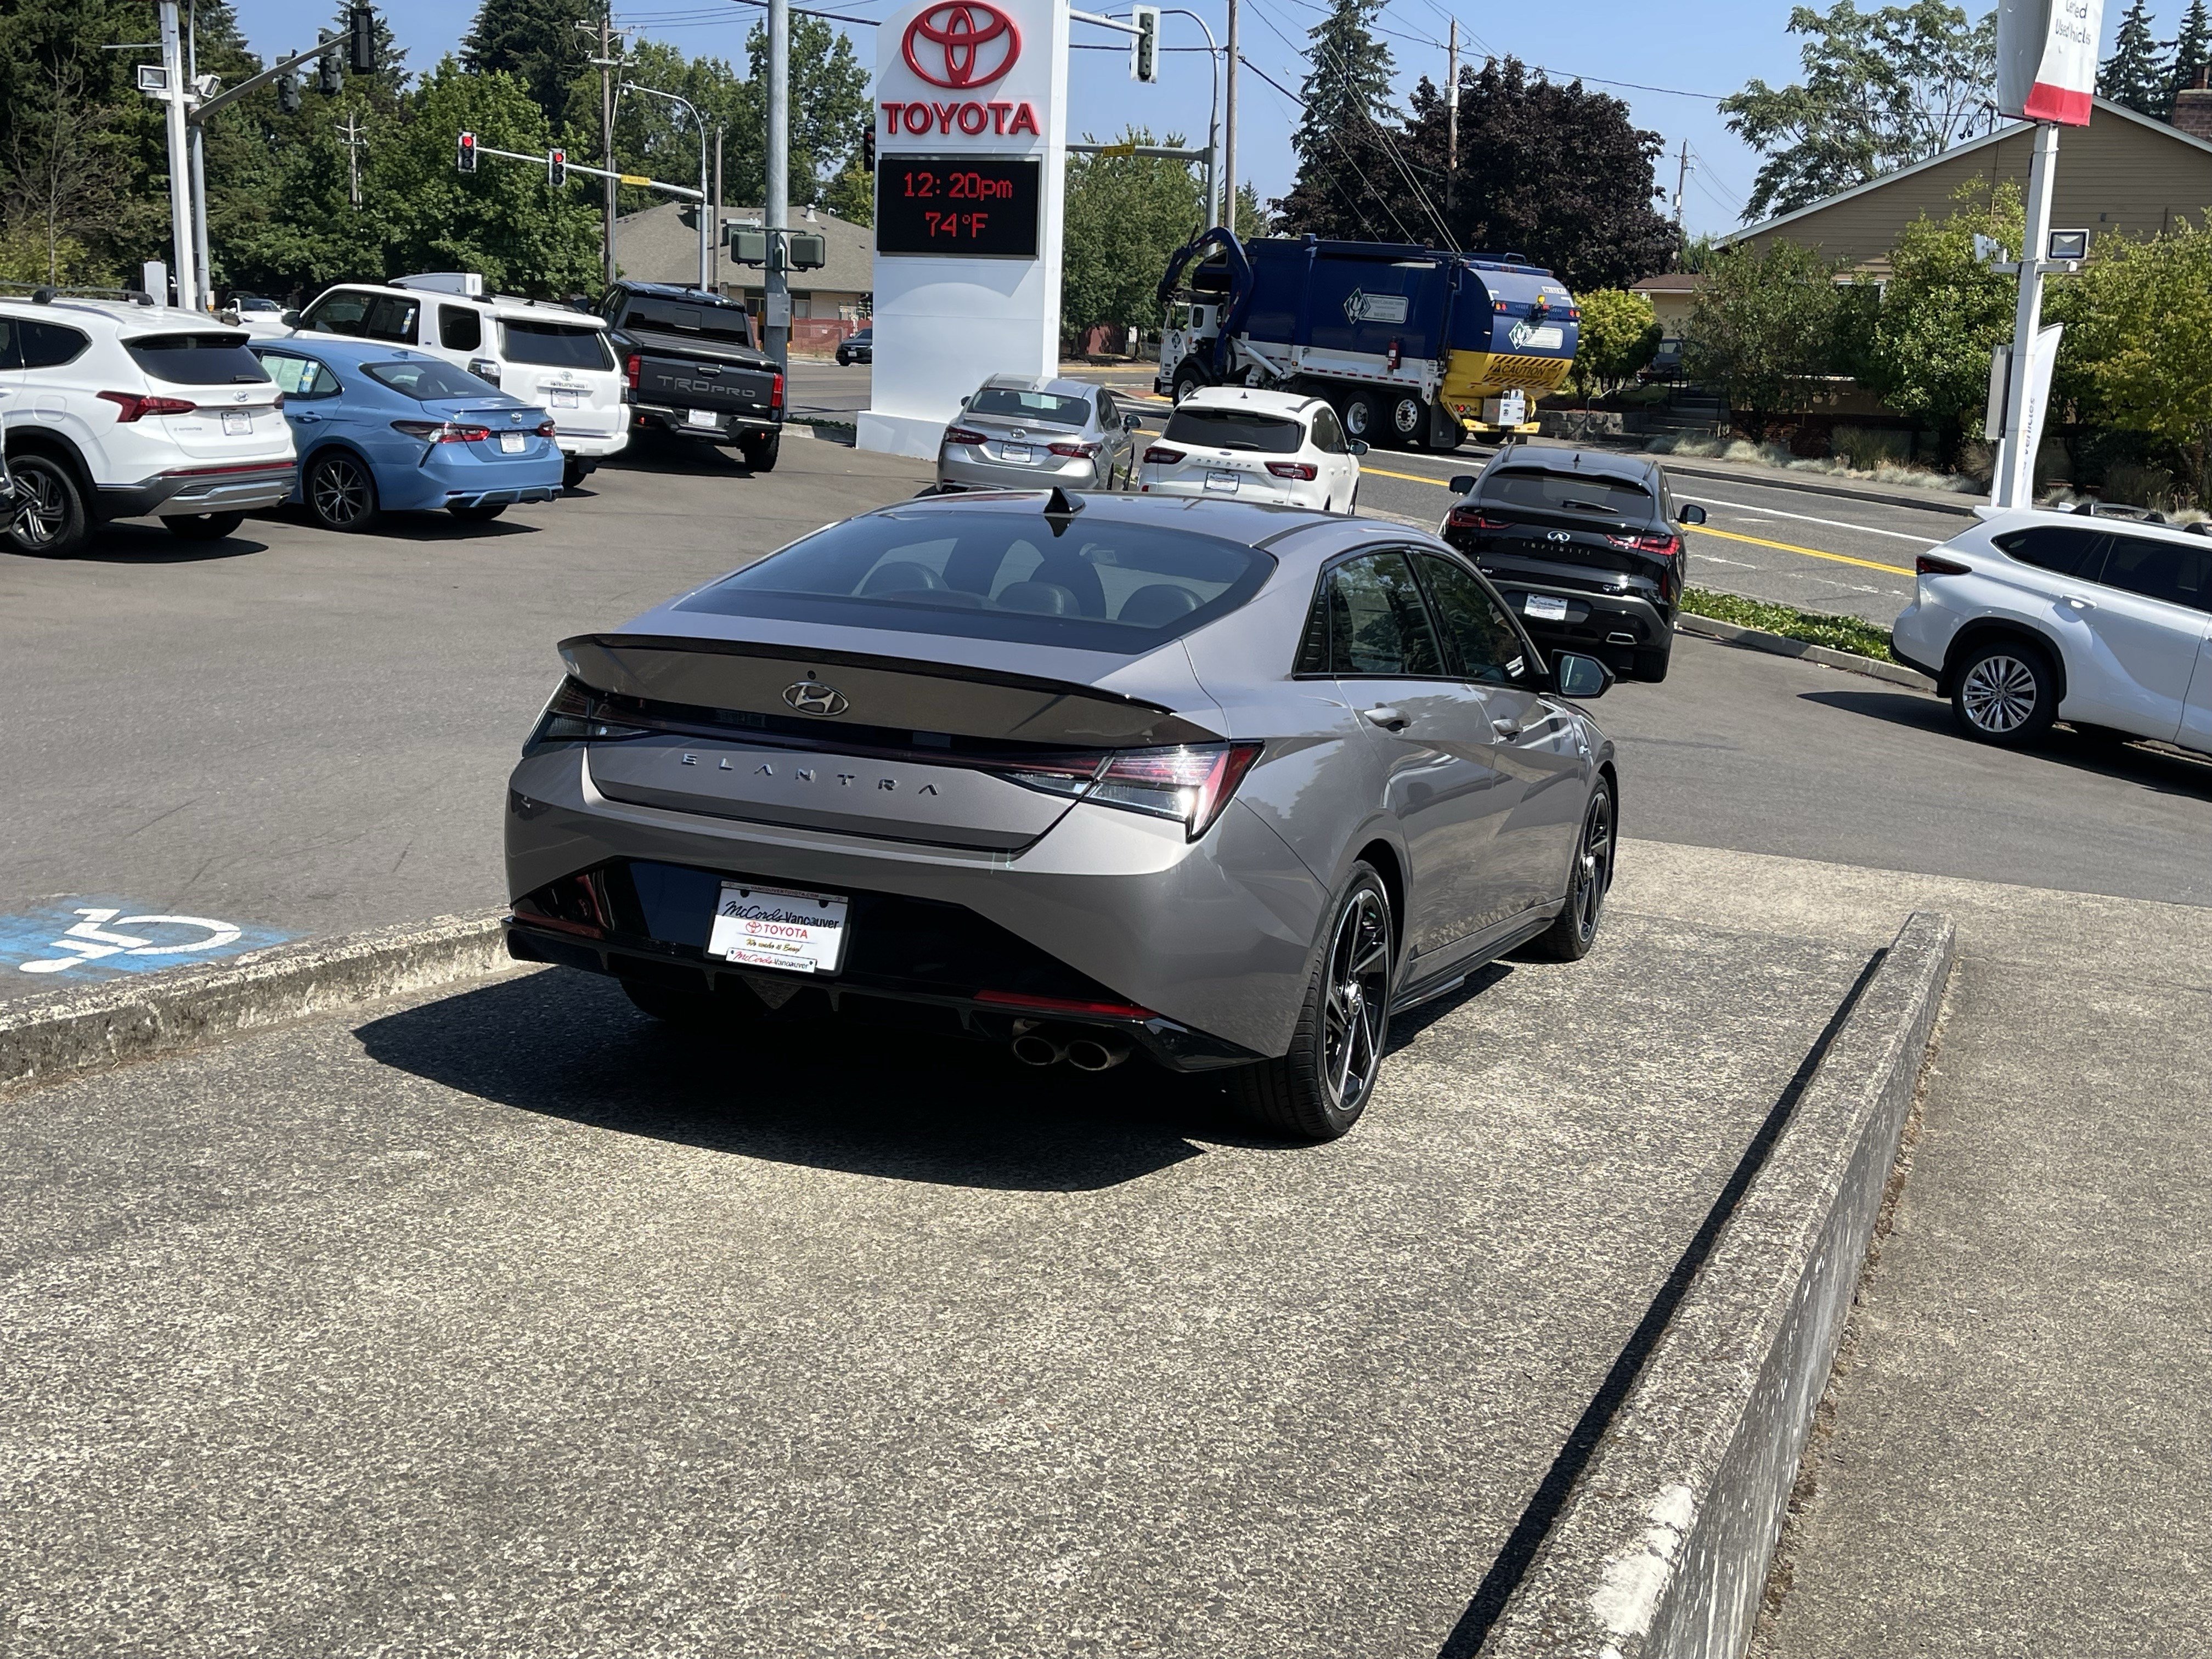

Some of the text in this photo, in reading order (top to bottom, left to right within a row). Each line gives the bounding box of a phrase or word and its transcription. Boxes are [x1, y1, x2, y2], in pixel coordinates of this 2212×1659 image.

[881, 101, 1040, 136] TOYOTA
[1502, 364, 1546, 376] CAUTION
[681, 753, 939, 795] ELANTRA
[764, 924, 808, 939] TOYOTA
